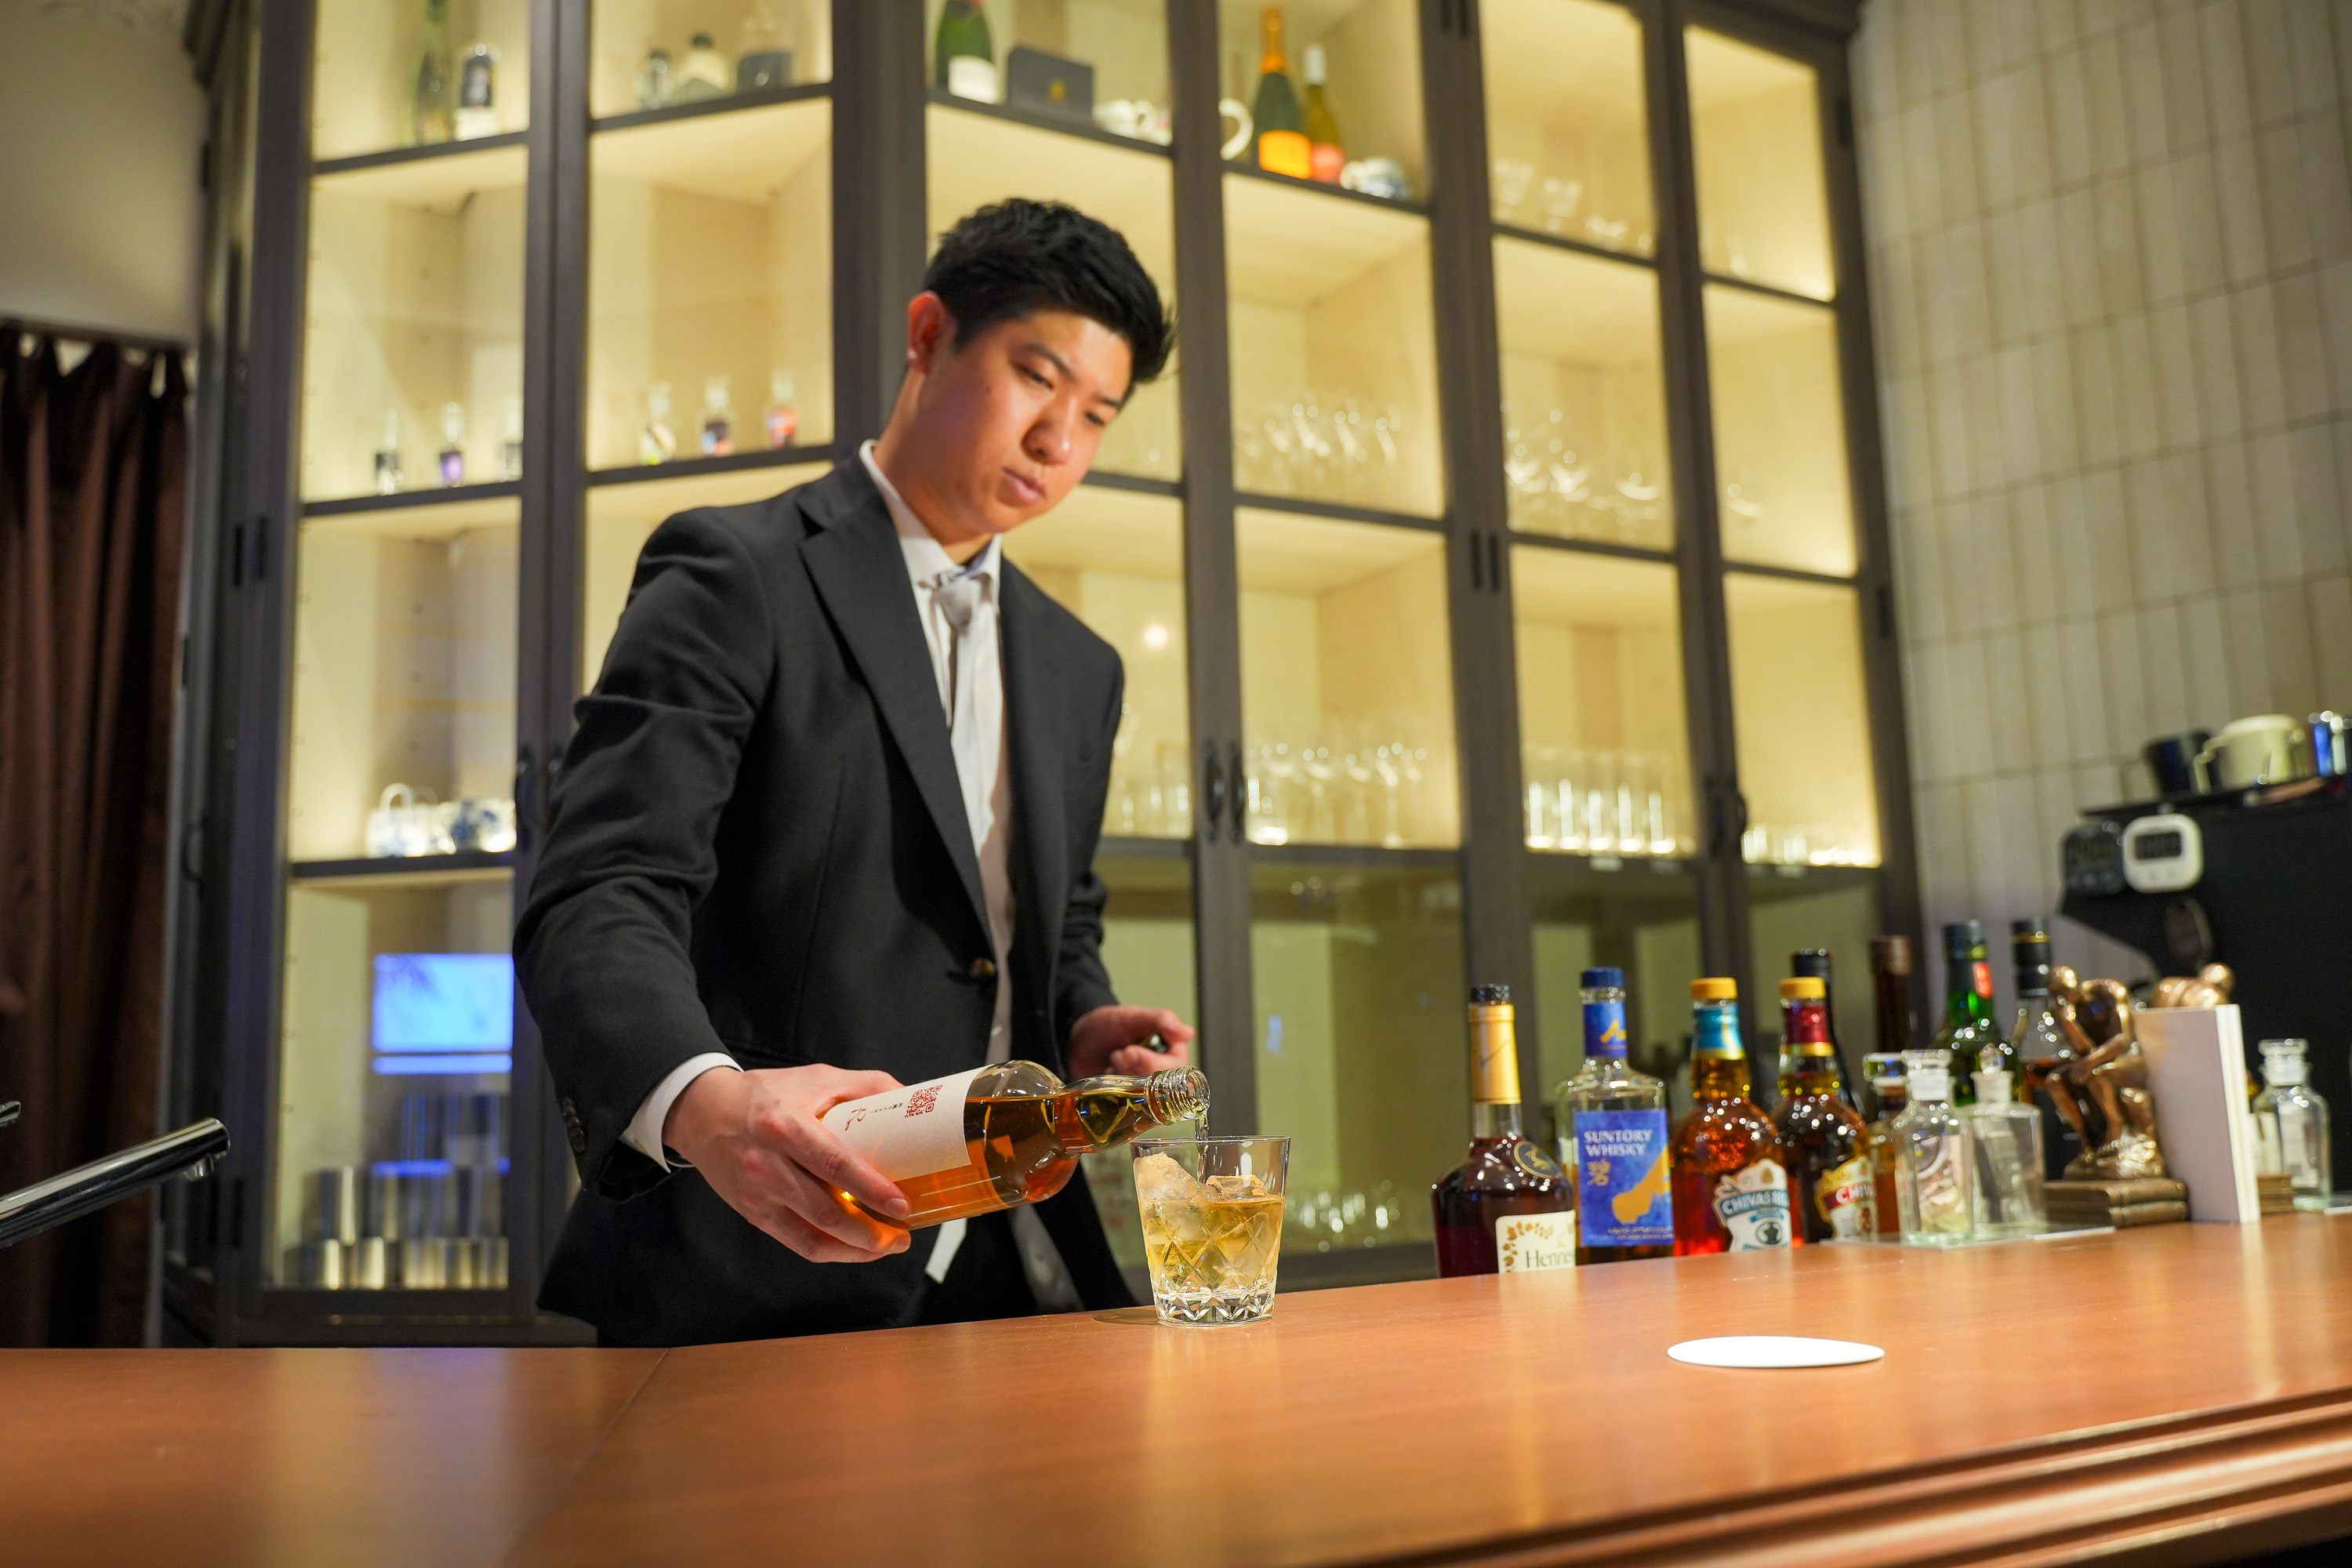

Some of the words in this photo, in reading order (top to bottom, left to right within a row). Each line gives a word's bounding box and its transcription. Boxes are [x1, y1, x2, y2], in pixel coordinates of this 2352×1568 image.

[1584, 1129, 1653, 1144] SUNTORY
[1585, 1143, 1646, 1157] WHISKY
[1722, 1190, 1772, 1215] CHIVAS
